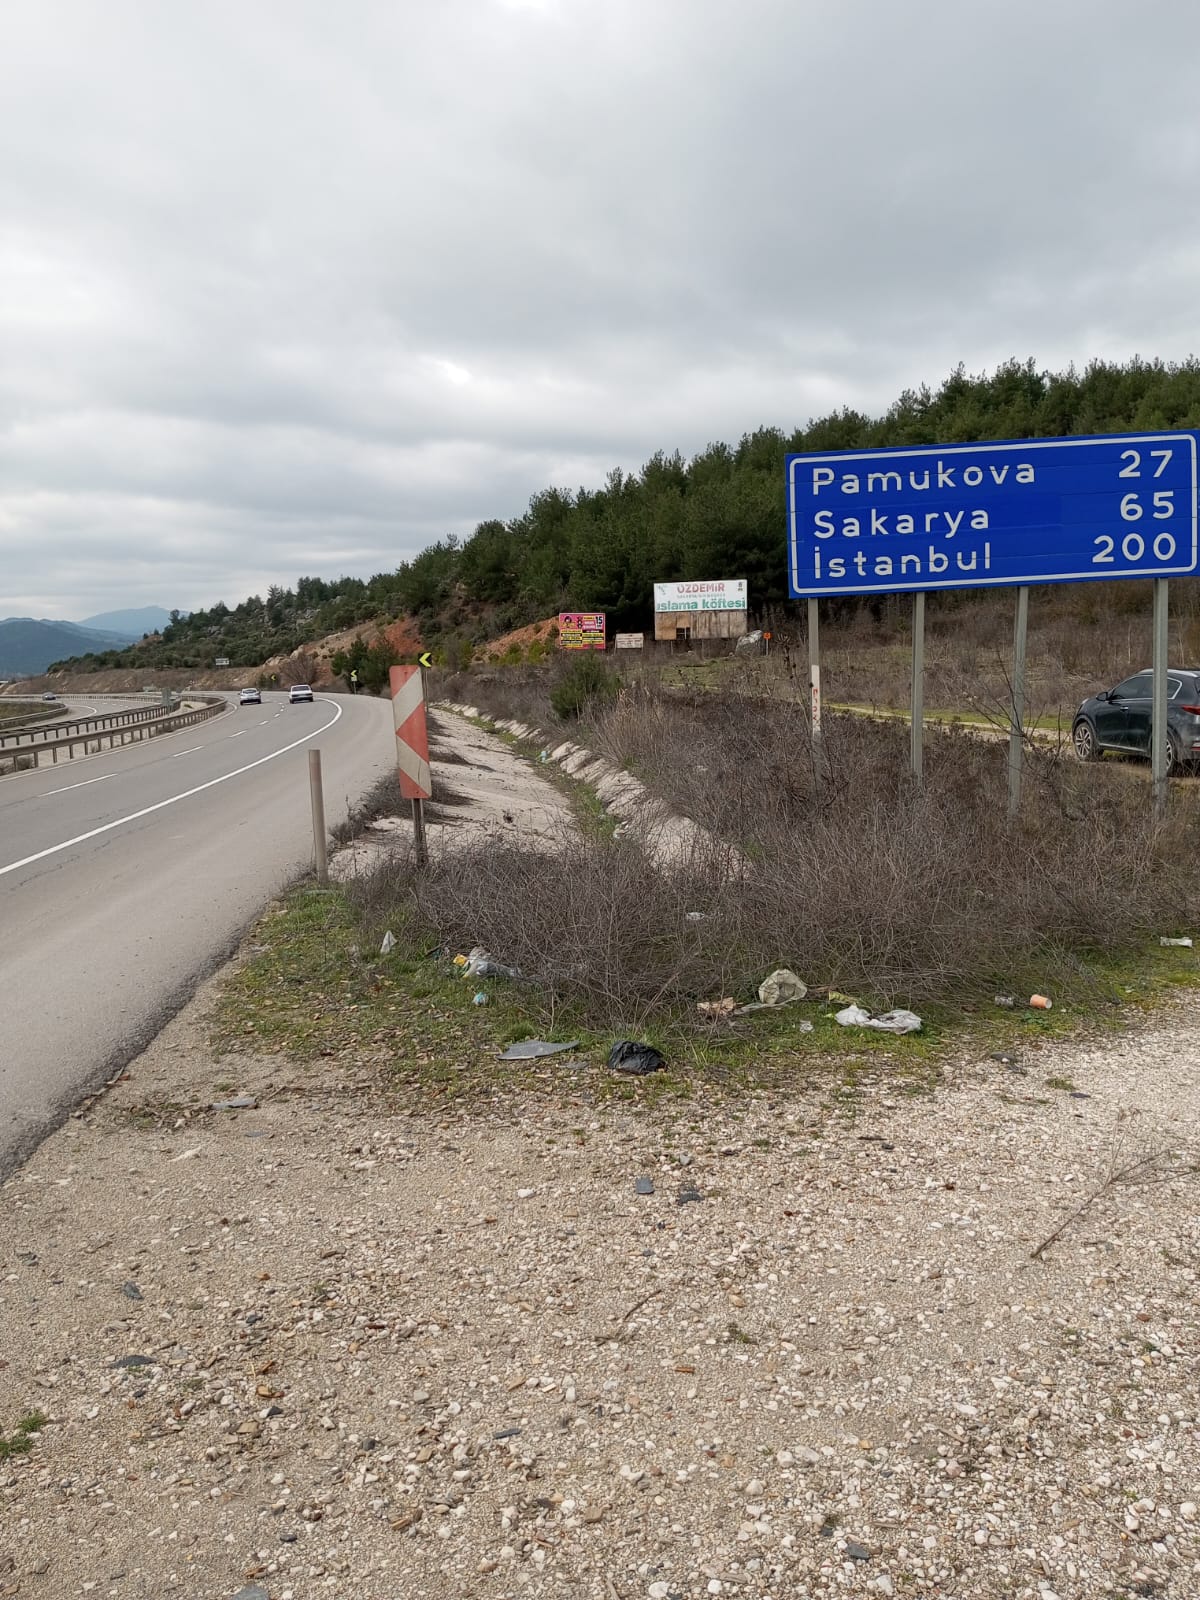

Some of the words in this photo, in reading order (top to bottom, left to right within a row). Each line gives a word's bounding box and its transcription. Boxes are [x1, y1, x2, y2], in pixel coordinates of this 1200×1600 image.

[812, 461, 1036, 495] Pamukova
[1118, 449, 1173, 478] 27
[813, 507, 990, 539] Sakarya
[1120, 491, 1174, 521] 65
[814, 542, 992, 580] İstanbul
[1092, 532, 1176, 563] 200
[677, 582, 725, 594] ÖZDEMİR
[702, 597, 746, 609] köftesi
